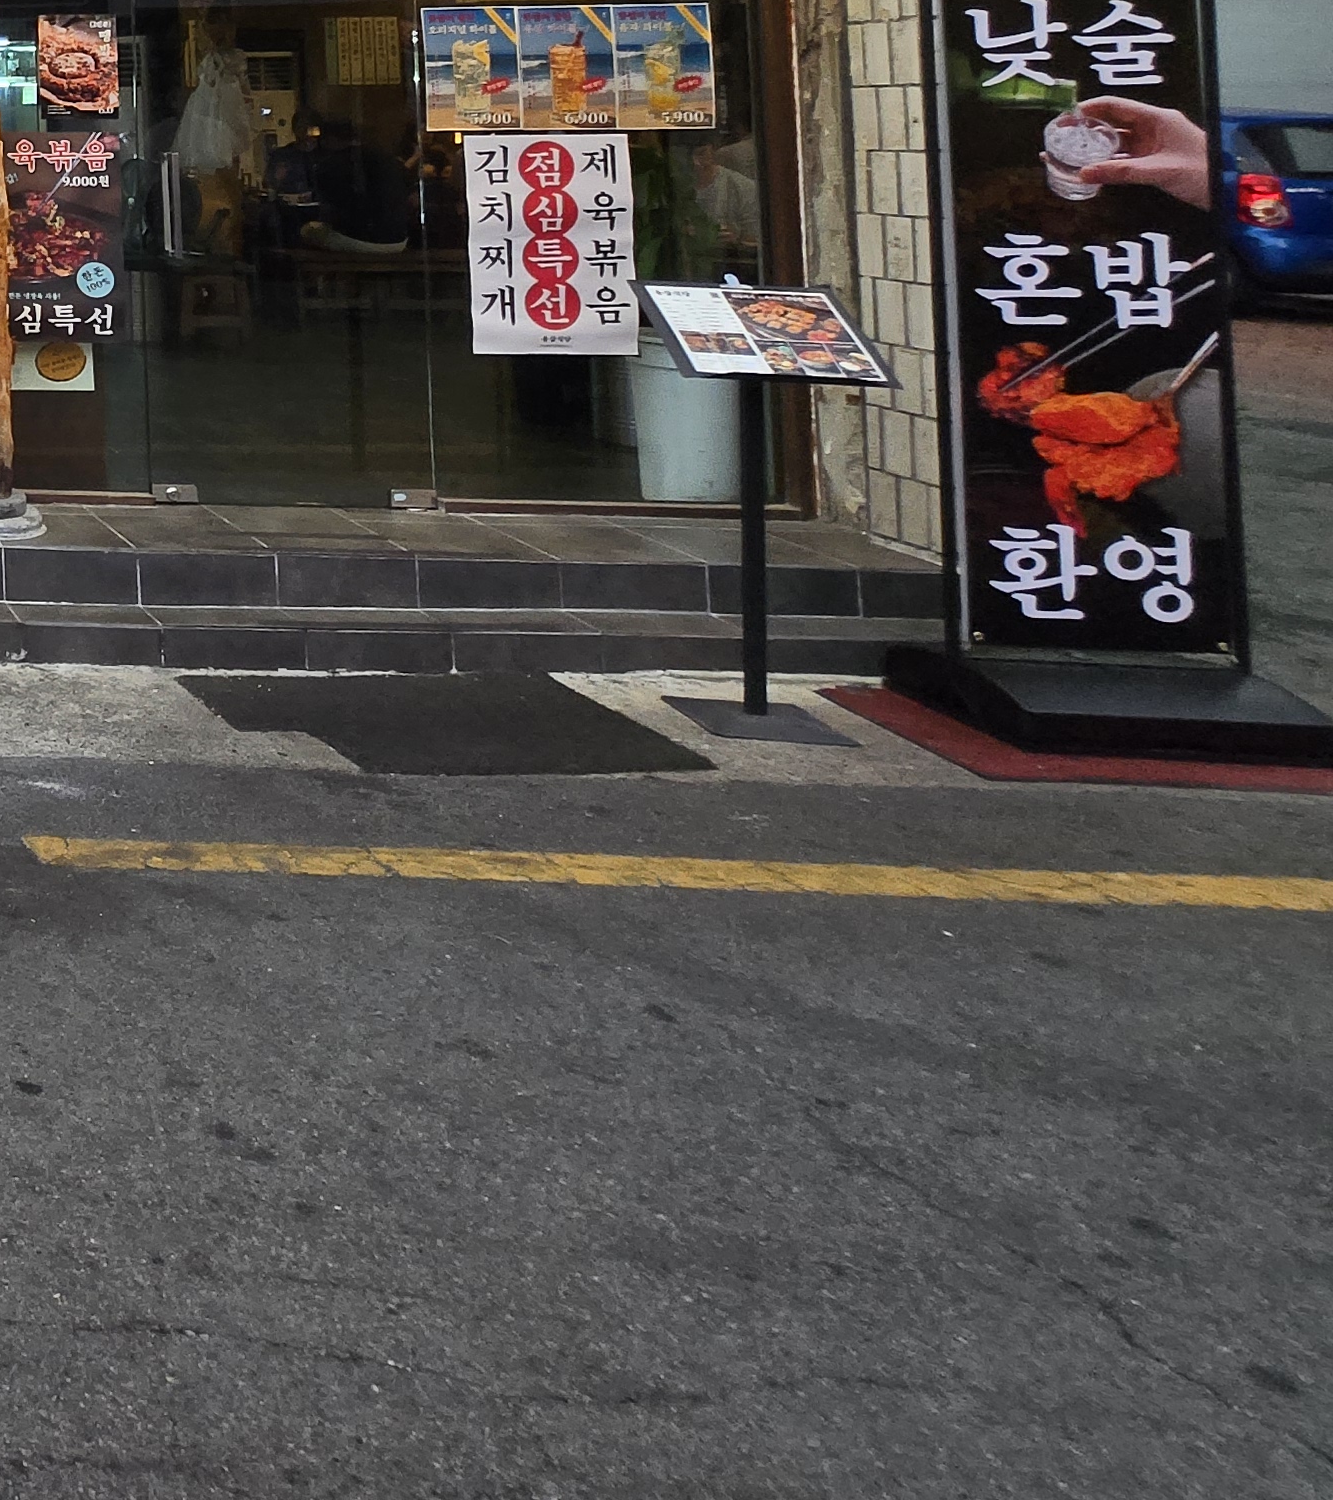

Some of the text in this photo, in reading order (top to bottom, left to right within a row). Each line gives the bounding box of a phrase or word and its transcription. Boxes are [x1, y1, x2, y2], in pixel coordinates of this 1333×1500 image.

[3, 138, 114, 173] 육볶음
[474, 144, 516, 326] 김치찌개
[524, 146, 573, 324] 점심특선
[580, 143, 632, 326] 제육볶음
[974, 231, 1195, 331] 혼밥
[6, 303, 114, 335] 심특선
[988, 524, 1196, 624] 환영
